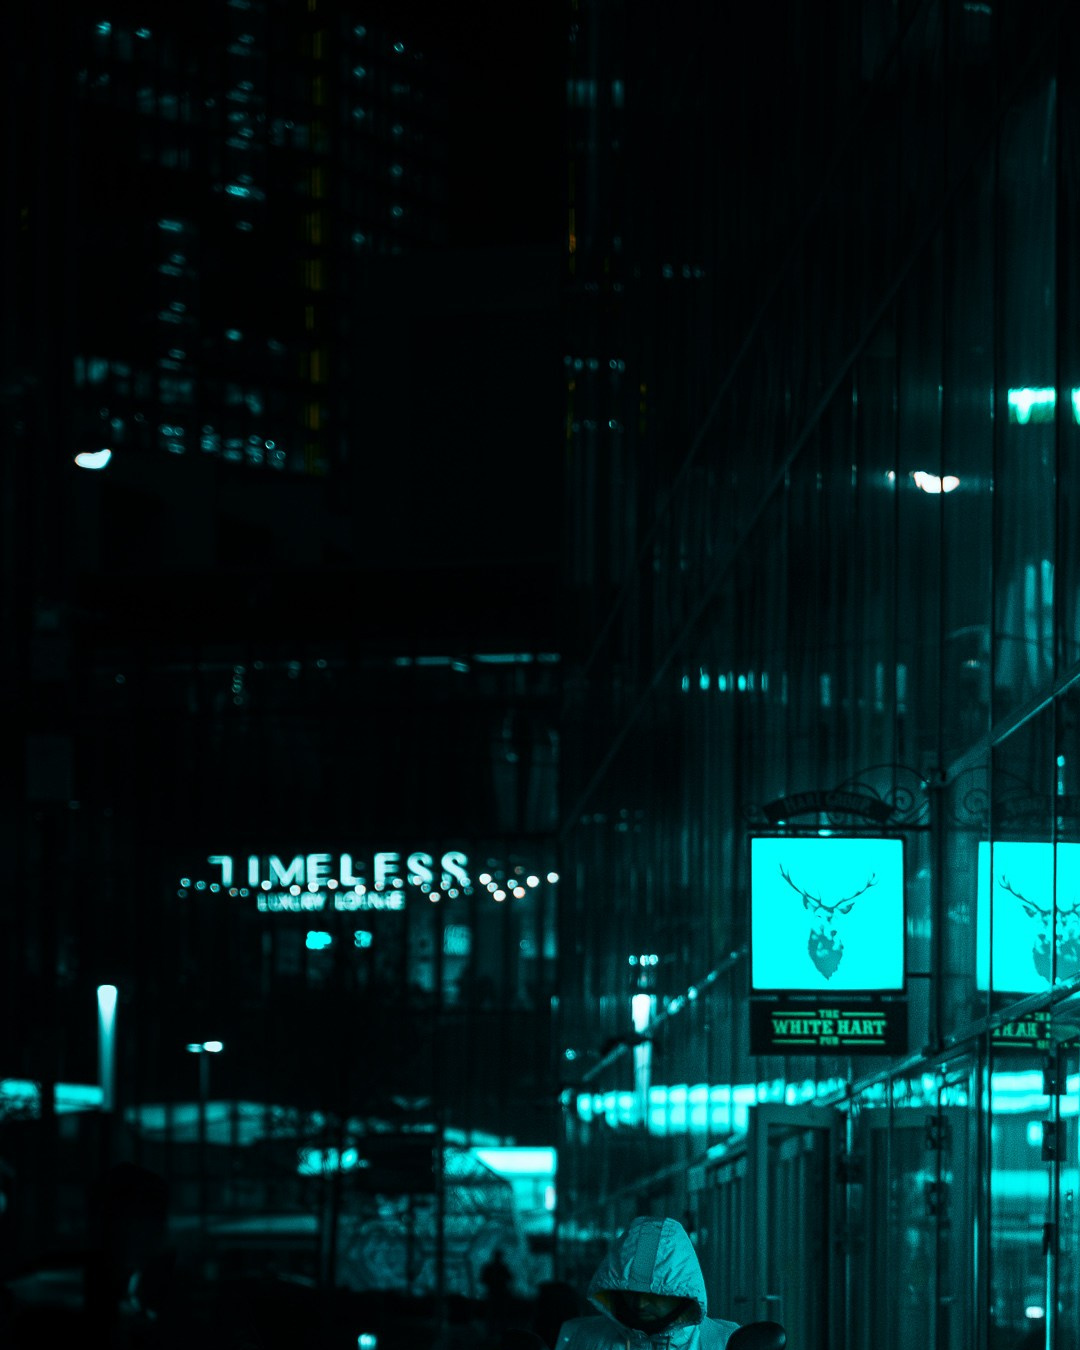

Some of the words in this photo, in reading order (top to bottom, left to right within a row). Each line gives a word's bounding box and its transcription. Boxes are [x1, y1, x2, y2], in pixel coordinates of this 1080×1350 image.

[818, 1010, 840, 1019] THE
[772, 1019, 834, 1035] WHITE
[837, 1019, 887, 1035] HART
